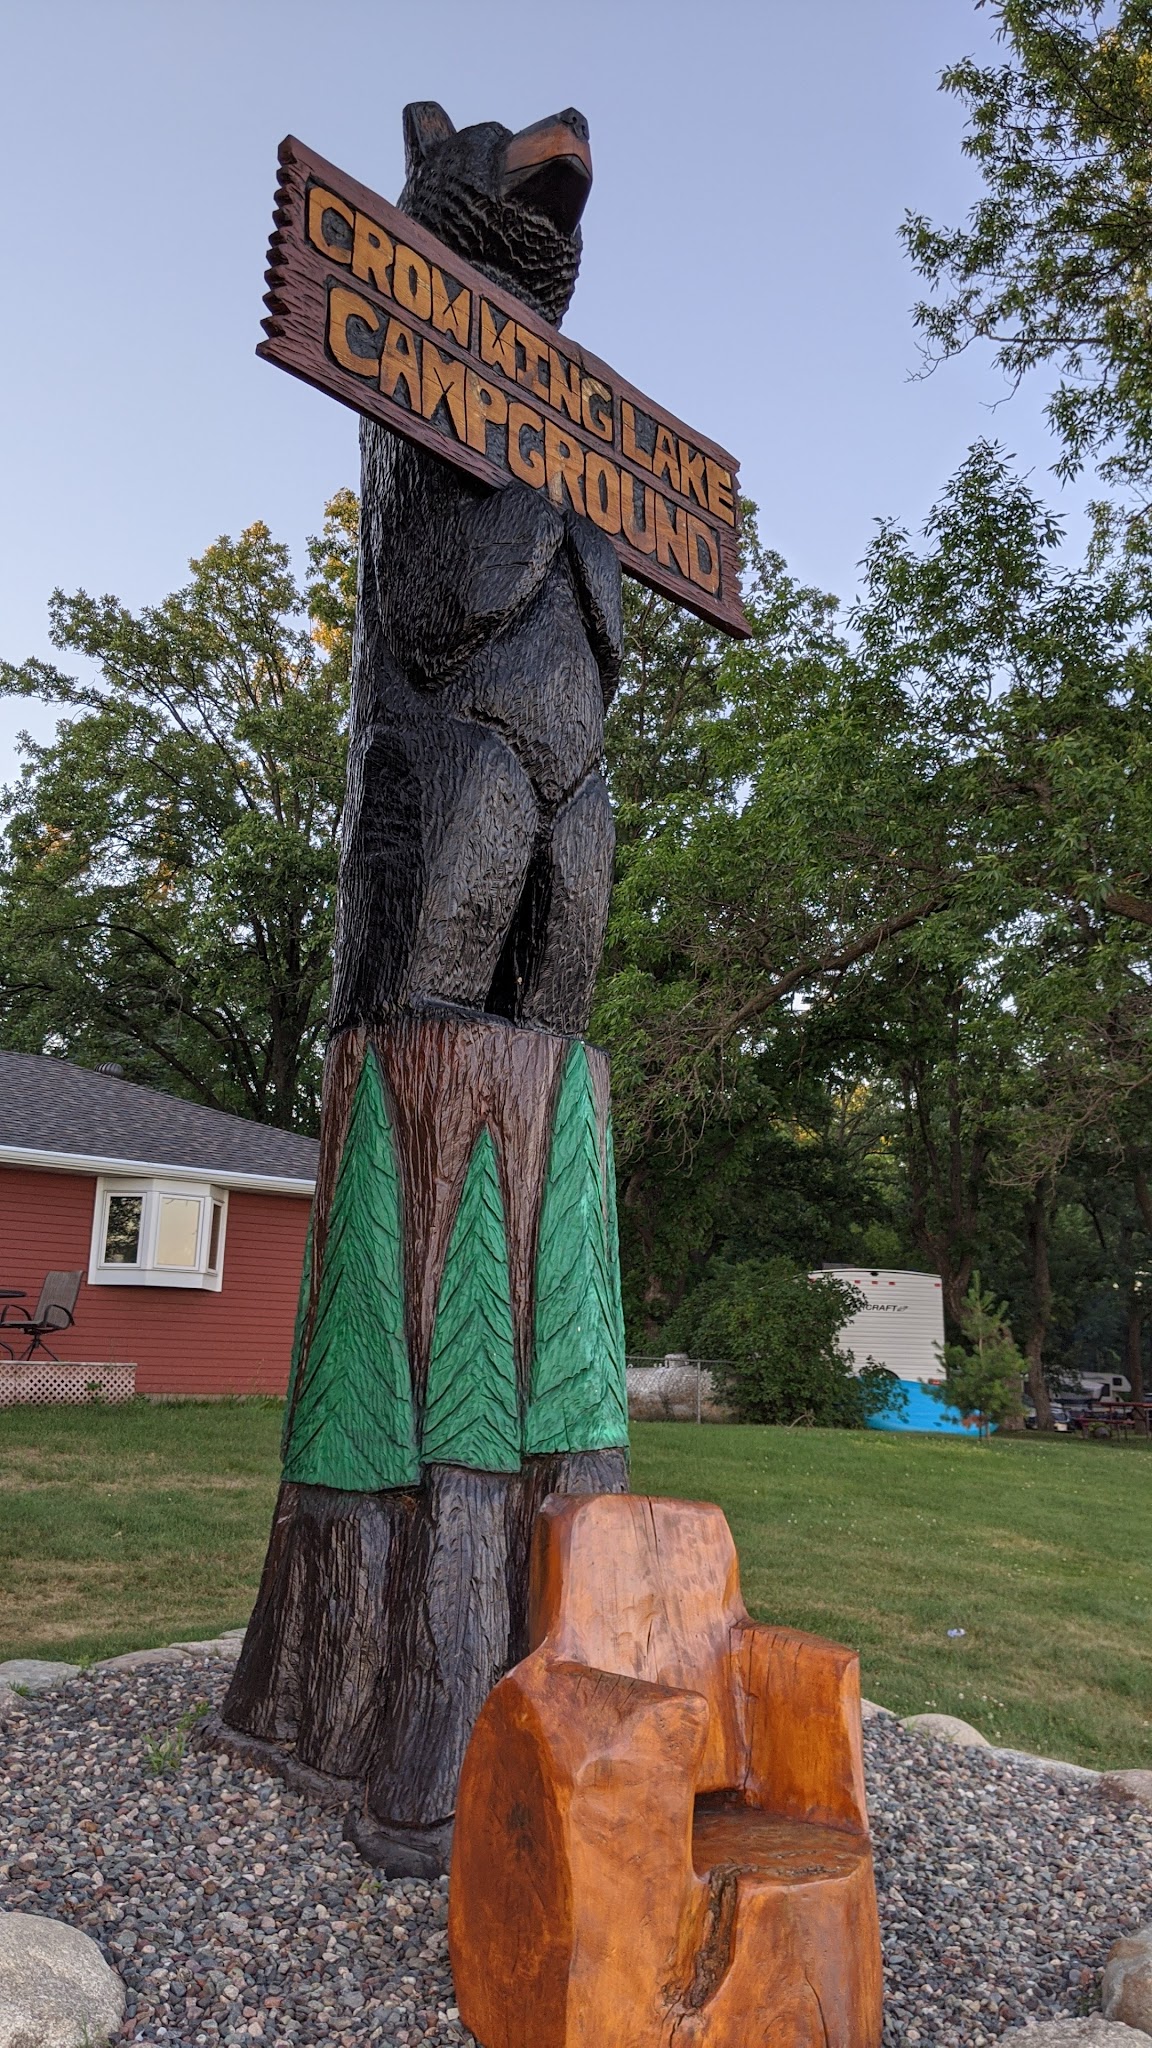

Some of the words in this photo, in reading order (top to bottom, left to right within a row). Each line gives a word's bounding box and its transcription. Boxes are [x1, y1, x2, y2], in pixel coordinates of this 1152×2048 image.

[308, 188, 473, 349] CROW
[480, 298, 614, 441] WING
[621, 401, 735, 527] LAKE
[327, 286, 721, 593] CAMPGROUND
